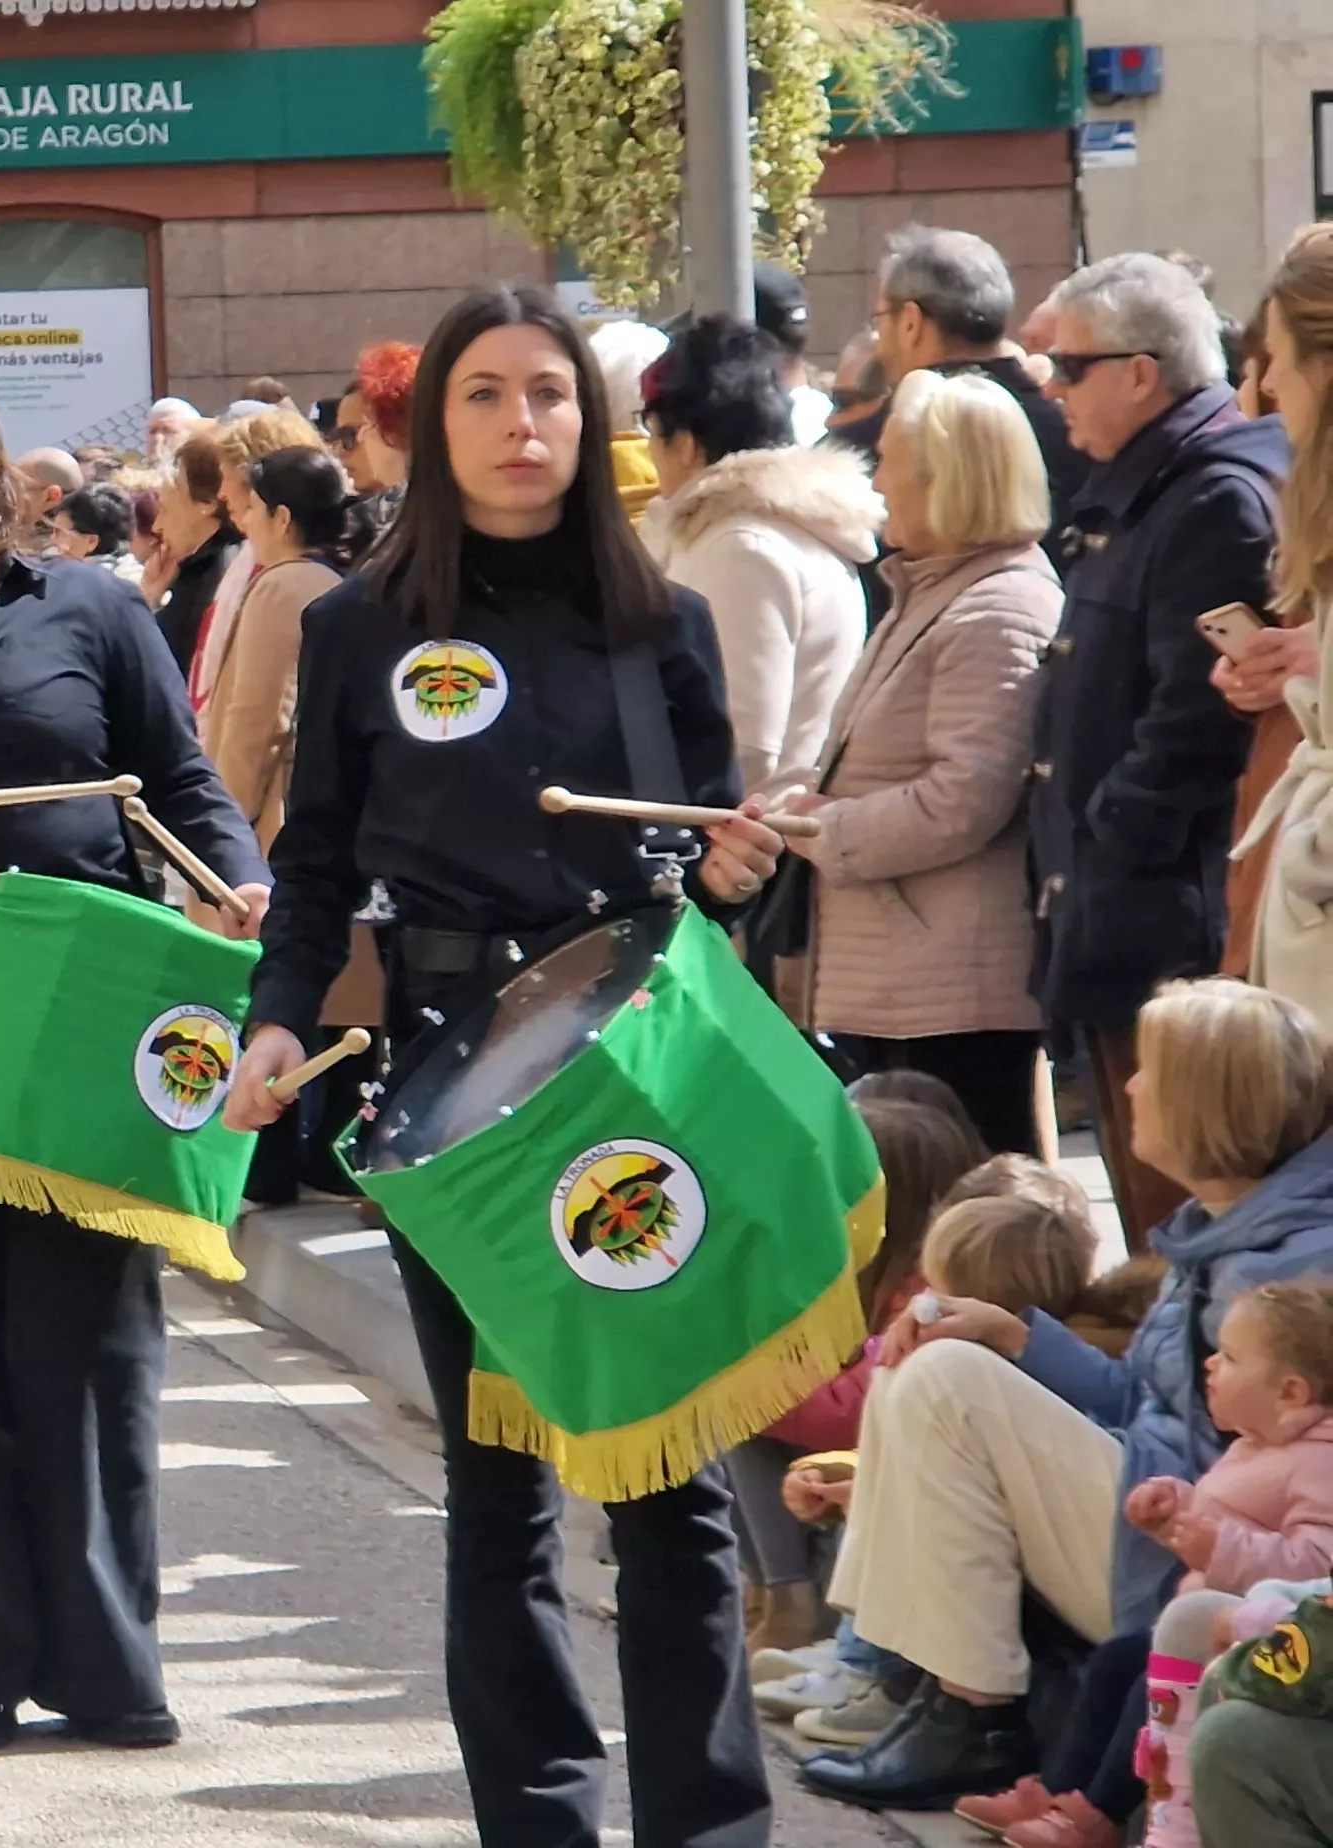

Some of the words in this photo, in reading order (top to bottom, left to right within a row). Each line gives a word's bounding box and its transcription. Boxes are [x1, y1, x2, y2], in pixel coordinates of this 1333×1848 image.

[68, 80, 194, 116] RURAL
[39, 118, 170, 149] ARAGÓN
[32, 311, 49, 325] tu
[27, 330, 79, 345] online
[32, 348, 103, 368] ventajas
[554, 1184, 569, 1201] LA
[563, 1144, 615, 1183] TRONADA
